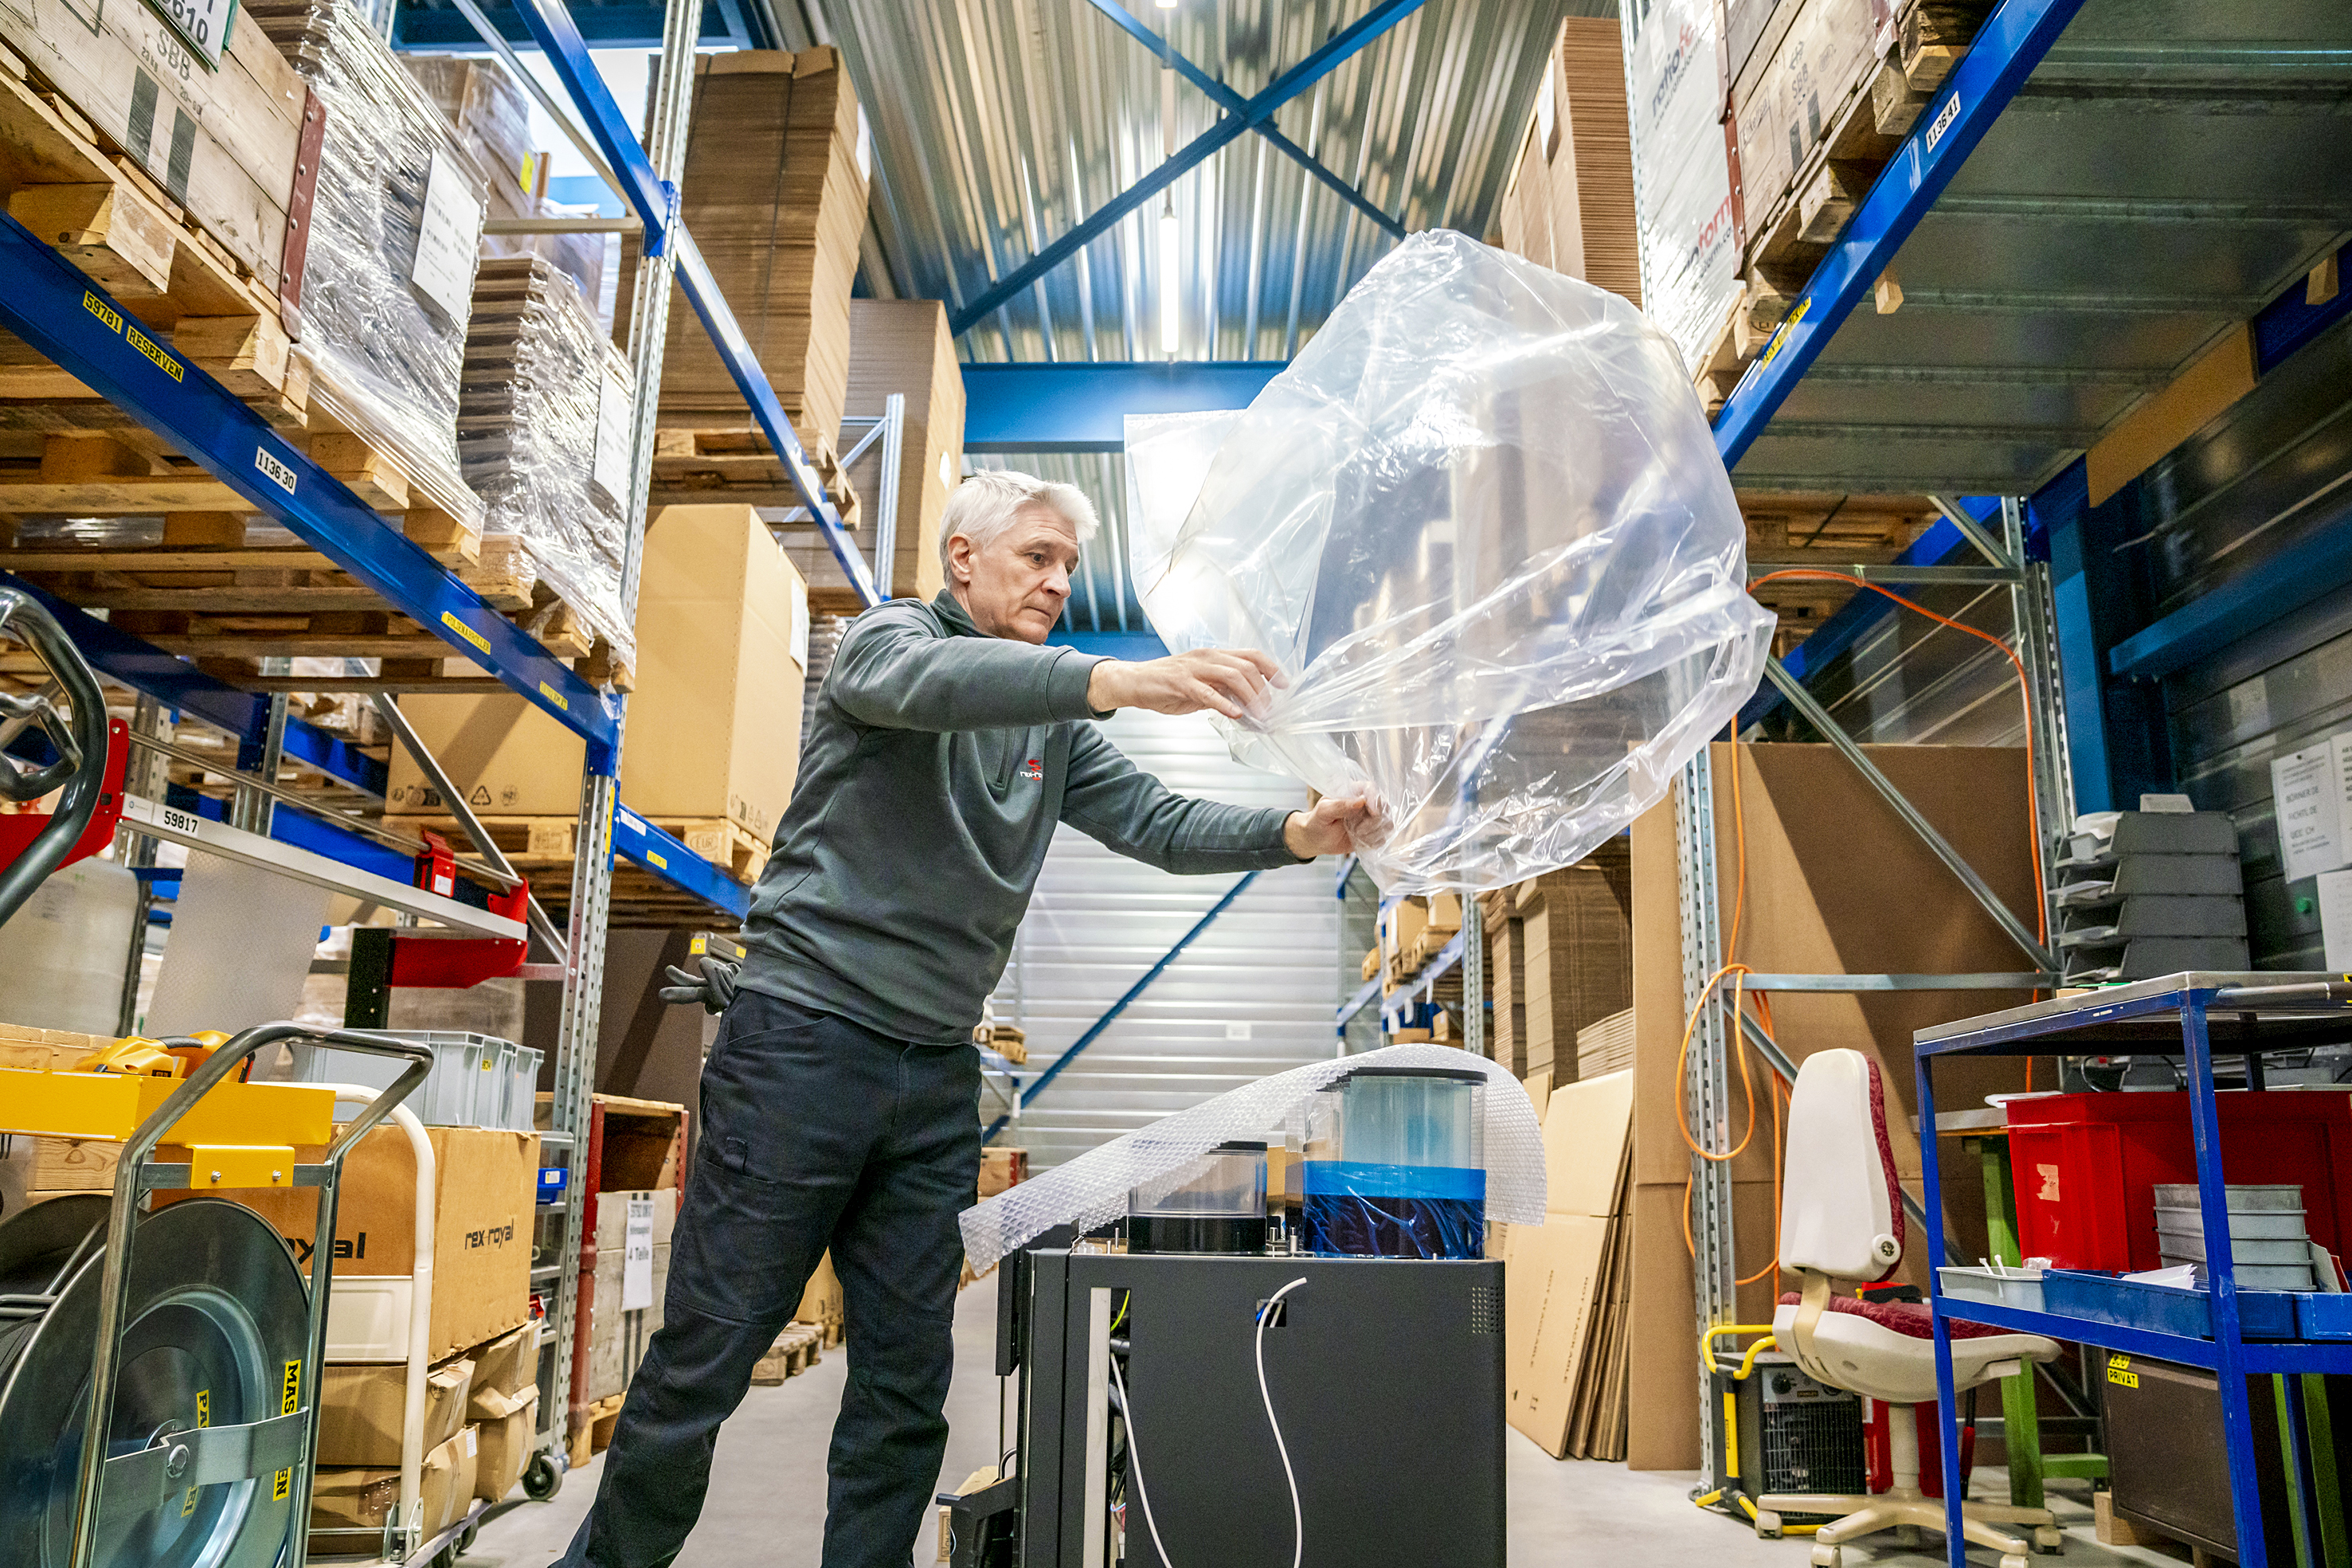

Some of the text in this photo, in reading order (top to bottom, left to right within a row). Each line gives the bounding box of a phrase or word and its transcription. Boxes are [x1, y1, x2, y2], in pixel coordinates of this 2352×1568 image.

[157, 29, 191, 81] SBB
[1791, 63, 1809, 100] SBB
[1928, 98, 1958, 147] 1136 41
[85, 294, 183, 381] 59781 RESERVEN
[258, 452, 295, 490] 1136 30
[164, 811, 198, 833] 59817
[2109, 1370, 2136, 1386] PRIVAT
